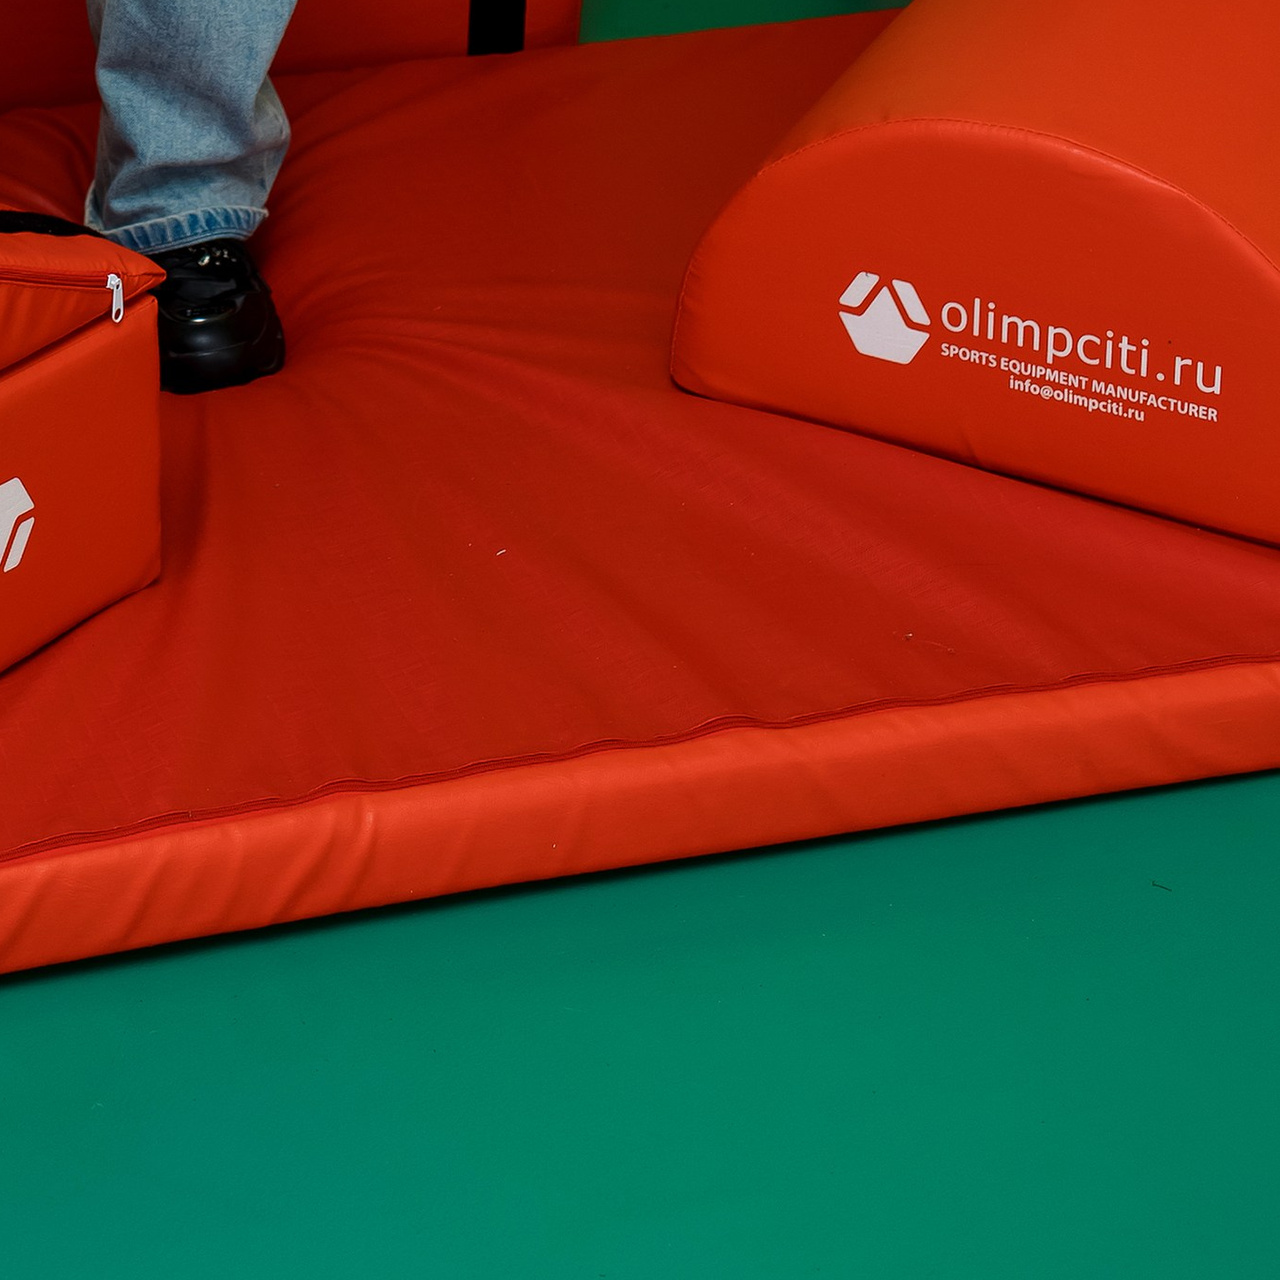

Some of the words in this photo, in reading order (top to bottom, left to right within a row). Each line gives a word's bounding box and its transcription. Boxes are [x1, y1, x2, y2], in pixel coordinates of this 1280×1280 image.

[941, 298, 1222, 394] olimpciti.ru
[941, 344, 997, 367] SPORTS
[1001, 357, 1089, 389] EQUIPMENT
[1092, 380, 1218, 422] MANUFACTURER
[1009, 375, 1145, 422] info@olimpciti.ru
